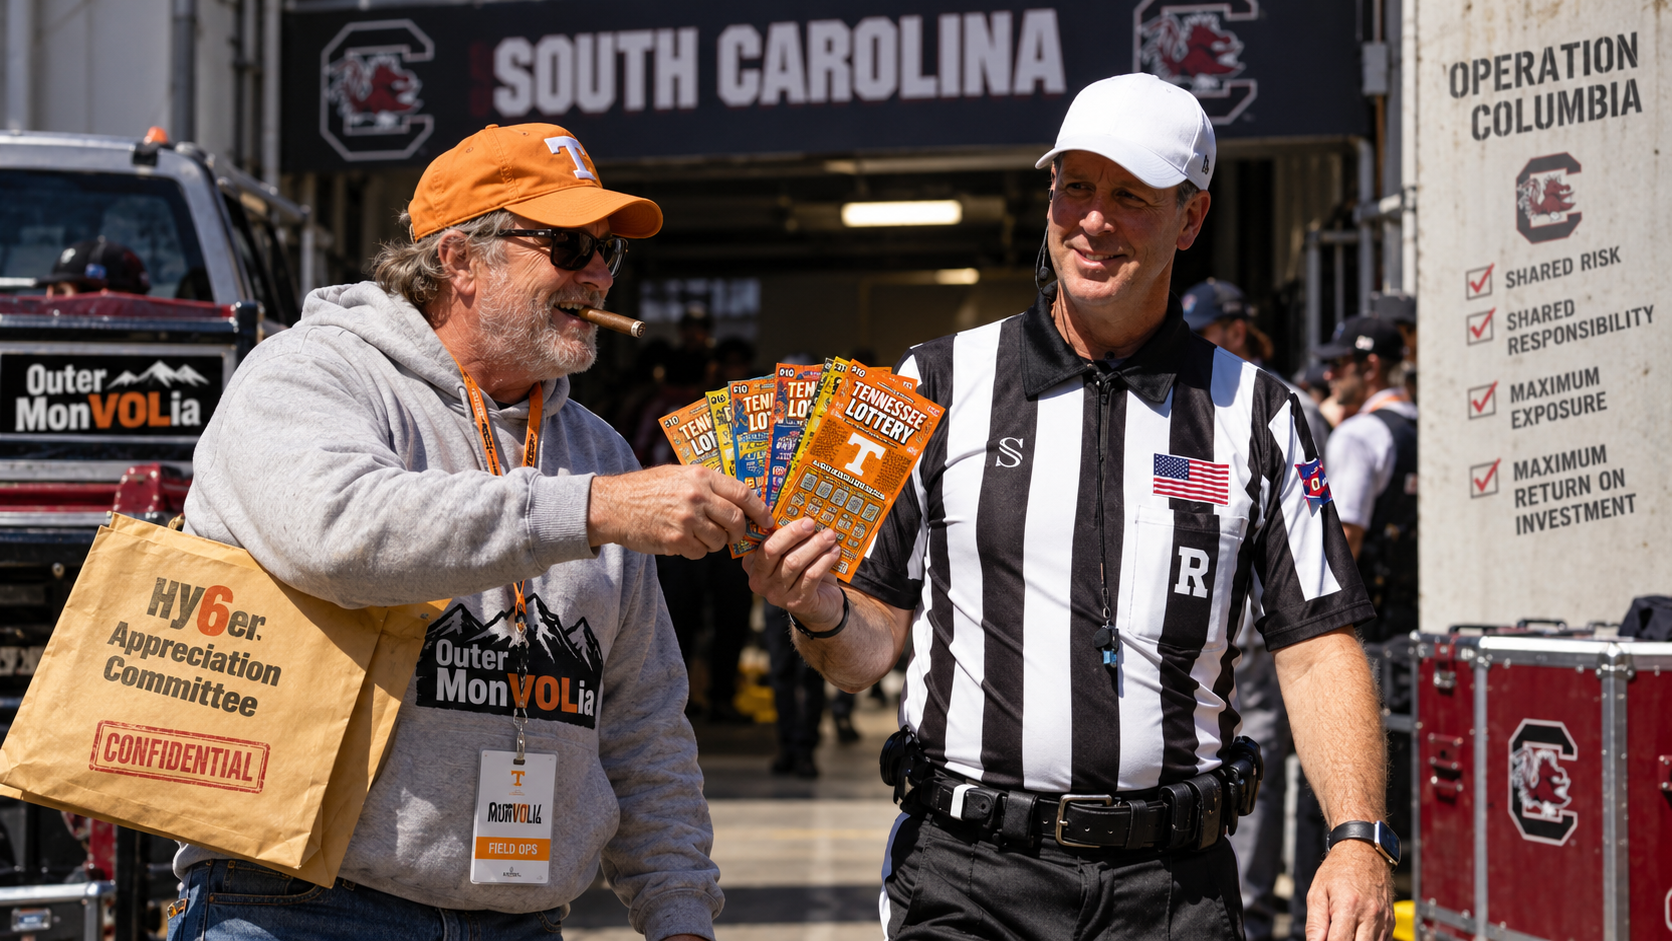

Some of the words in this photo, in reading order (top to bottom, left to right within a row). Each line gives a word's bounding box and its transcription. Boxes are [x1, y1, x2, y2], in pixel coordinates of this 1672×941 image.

[493, 28, 698, 117] SOUTH
[717, 10, 1066, 107] CAROLINA
[1449, 31, 1638, 99] OPERATION
[1471, 78, 1643, 141] COLUMBIA
[544, 135, 596, 181] T
[1505, 257, 1574, 289] SHARED
[1580, 245, 1621, 271] RISK
[1507, 299, 1575, 331] SHARED
[1508, 304, 1654, 356] RESPONSIBILITY
[26, 363, 107, 396] Outer
[1510, 366, 1601, 403] MAXIMUM
[15, 391, 200, 431] MonVOLia
[845, 398, 915, 445] LOTTERY
[852, 381, 928, 431] TENNESSEE
[1511, 391, 1608, 429] EXPOSURE
[847, 432, 886, 476] T
[995, 437, 1023, 468] S
[1513, 444, 1607, 481] MAXIMUM
[1515, 474, 1592, 508] RETURN
[1599, 468, 1626, 491] ON
[1516, 493, 1636, 536] INVESTMENT
[1174, 546, 1210, 598] R
[107, 621, 282, 687] Appreciation
[435, 638, 509, 671] Outer
[103, 655, 258, 717] Committee
[436, 667, 595, 716] MonVOLia
[103, 732, 253, 782] CONFIDENTIAL
[511, 770, 525, 787] T
[488, 842, 516, 854] FIELD
[518, 843, 538, 855] OPS
